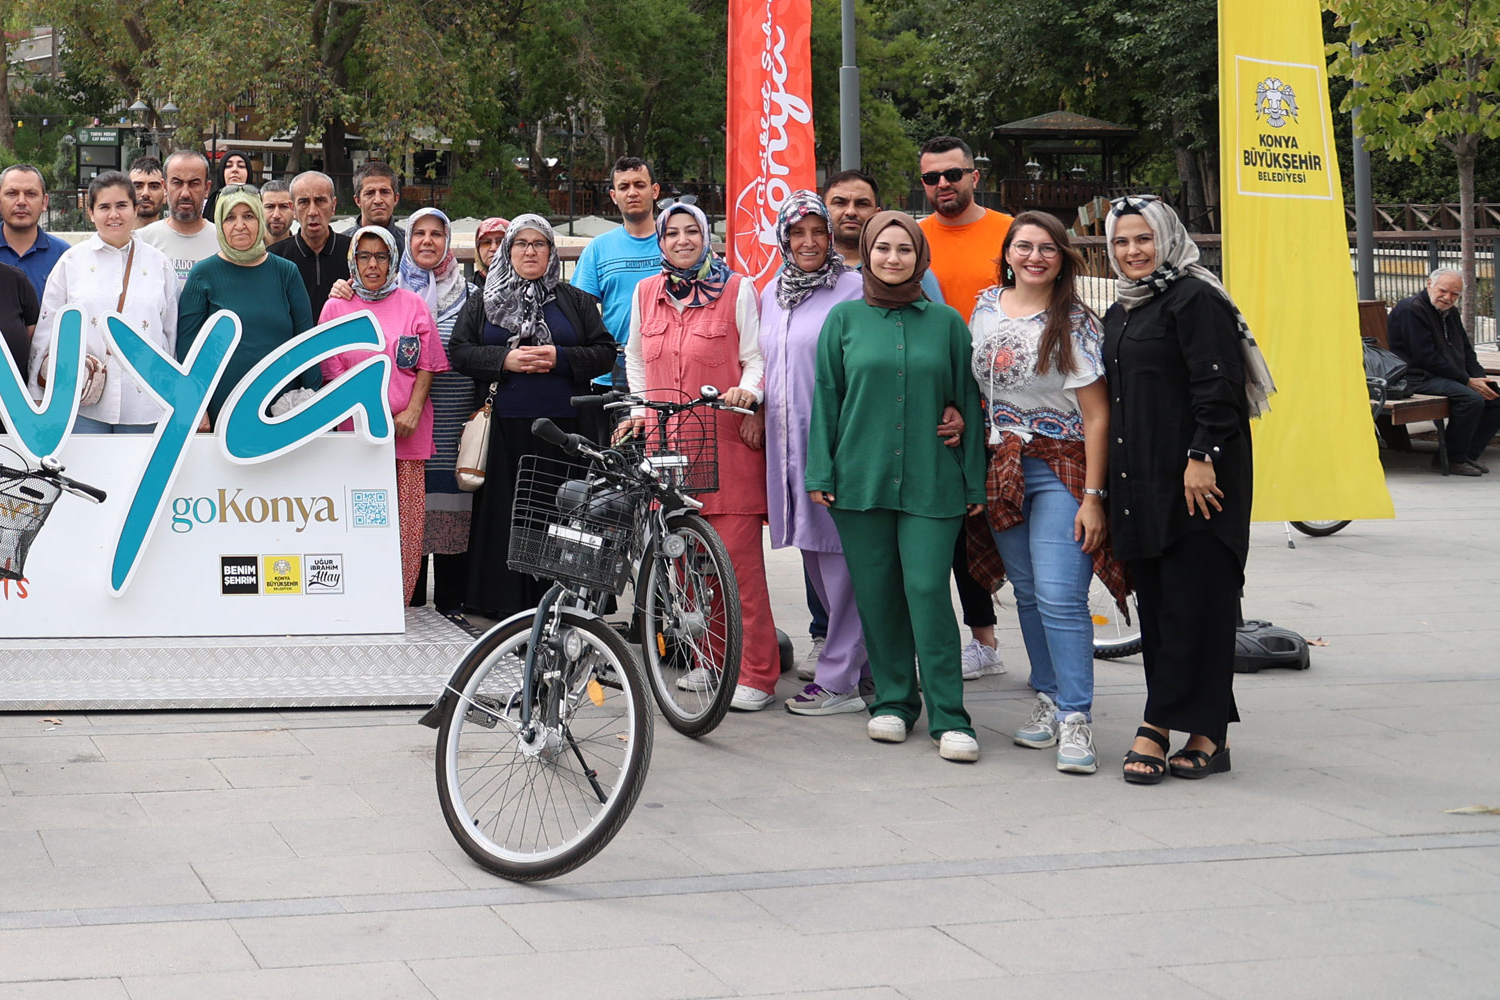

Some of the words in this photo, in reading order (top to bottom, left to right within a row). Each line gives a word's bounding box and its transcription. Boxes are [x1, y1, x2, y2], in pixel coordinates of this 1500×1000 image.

[1258, 133, 1299, 150] KONYA
[1243, 147, 1322, 173] BÜYÜKŞEHİR
[1257, 170, 1307, 184] BELEDİYESİ
[171, 488, 339, 533] goKonya
[223, 565, 256, 576] BENİM
[223, 575, 257, 586] ŞEHRİM
